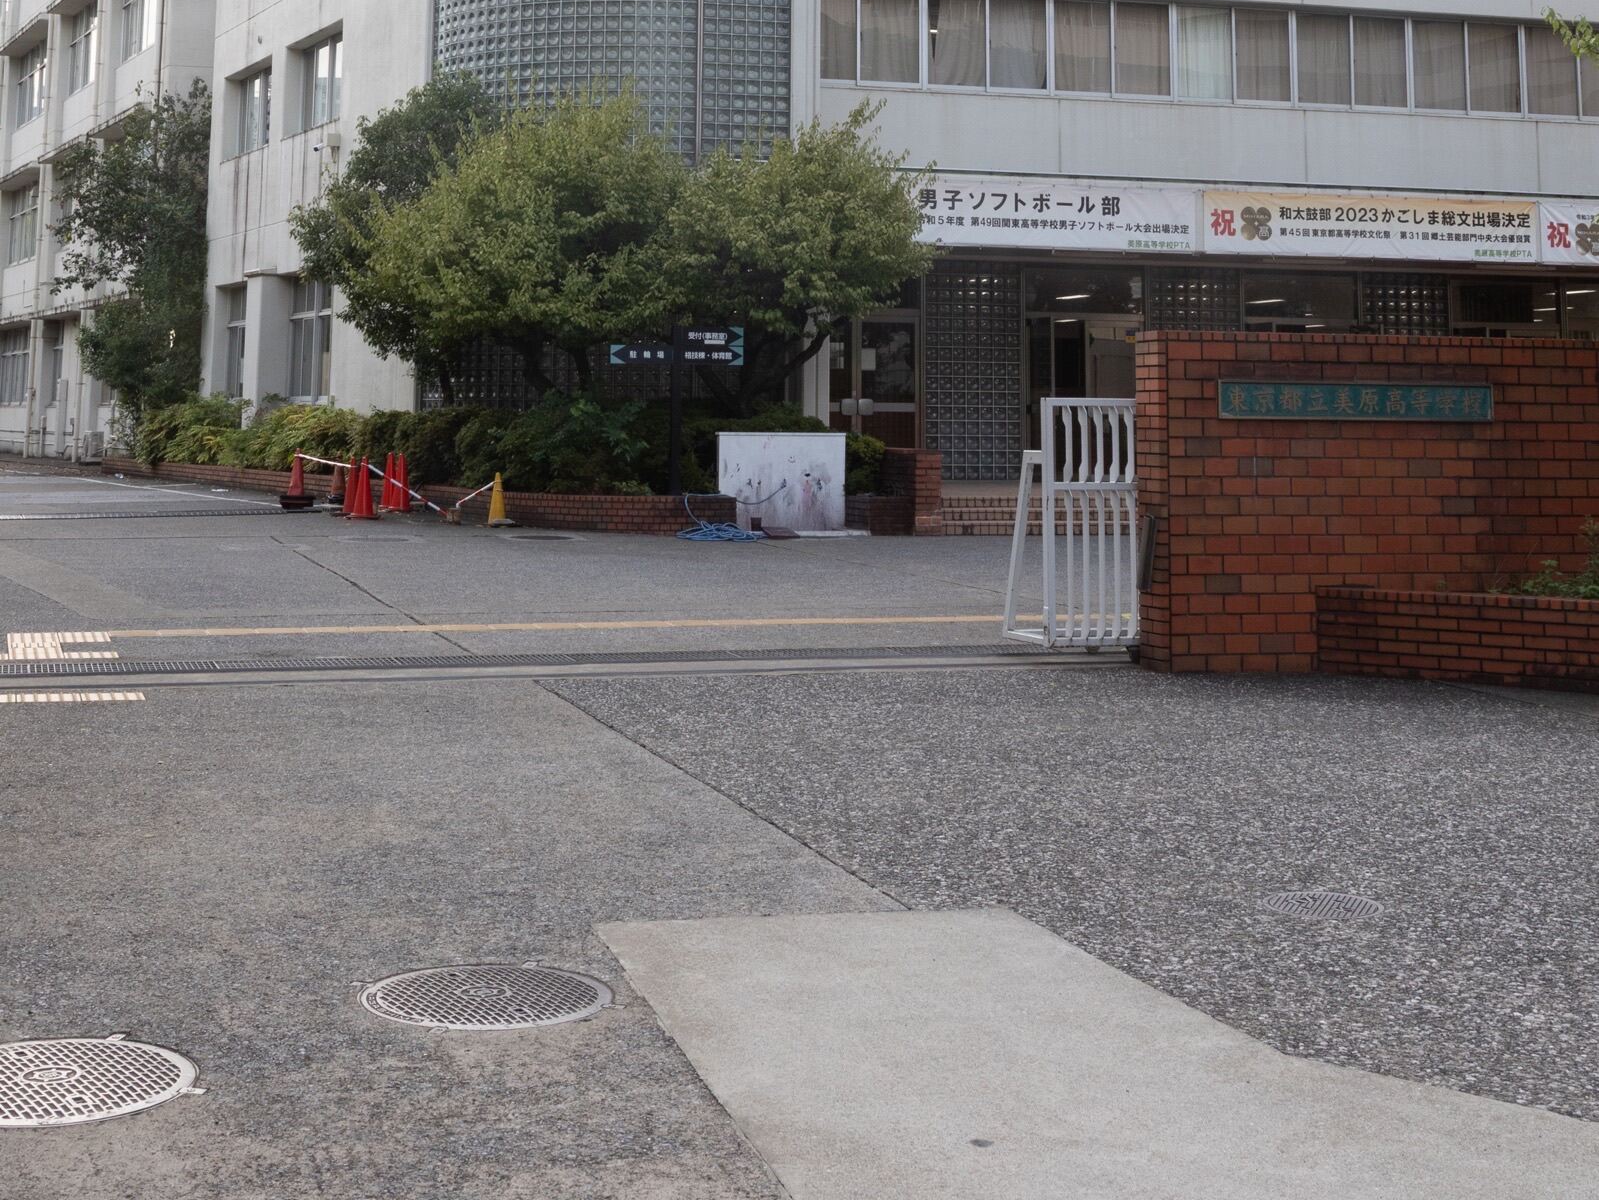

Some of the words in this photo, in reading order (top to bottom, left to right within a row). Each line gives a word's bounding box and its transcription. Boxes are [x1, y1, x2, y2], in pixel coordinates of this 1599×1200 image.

[919, 188, 1121, 217] 男子ソフトボール部
[1210, 208, 1236, 237] 祝
[1547, 221, 1571, 249] 祝
[1227, 385, 1482, 416] 東京都立美原高等学校
